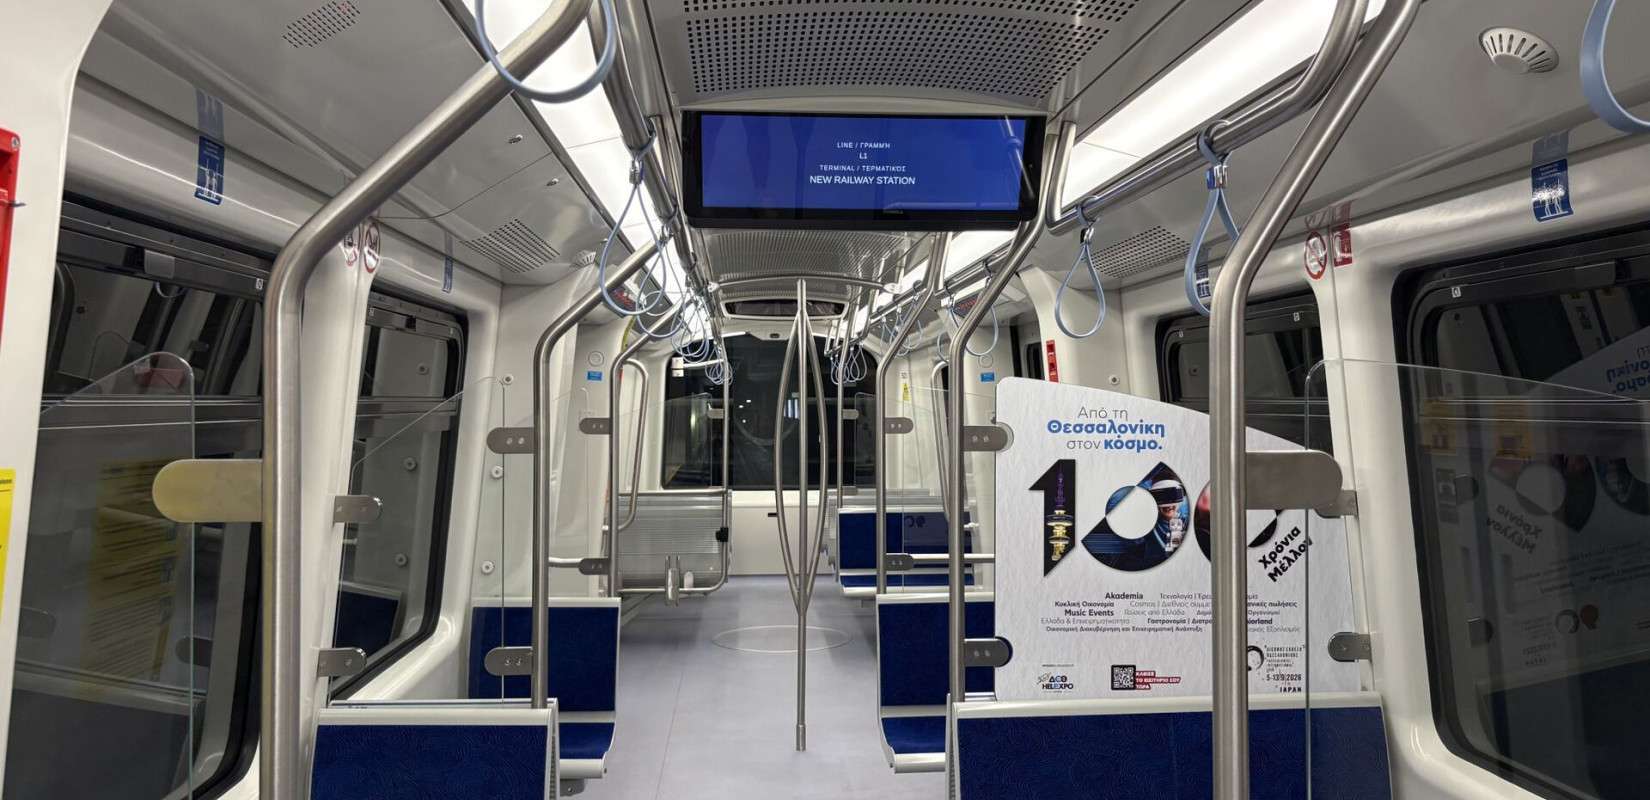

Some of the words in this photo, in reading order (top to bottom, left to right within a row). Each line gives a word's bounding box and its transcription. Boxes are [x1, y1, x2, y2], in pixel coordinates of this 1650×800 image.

[820, 164, 855, 172] TERMINAL
[809, 175, 833, 184] NEW
[834, 176, 874, 185] RAILWAY
[876, 176, 916, 185] STATION
[1078, 406, 1108, 419] Από
[1113, 409, 1128, 421] τη
[1047, 419, 1165, 438] Θεσσαλονίκη
[1066, 440, 1101, 450] στον
[1104, 434, 1163, 453] κόσμο.
[1258, 526, 1301, 569] Χρόνια
[1105, 591, 1144, 600] Akademia
[1160, 592, 1193, 600] Τεχνολογία
